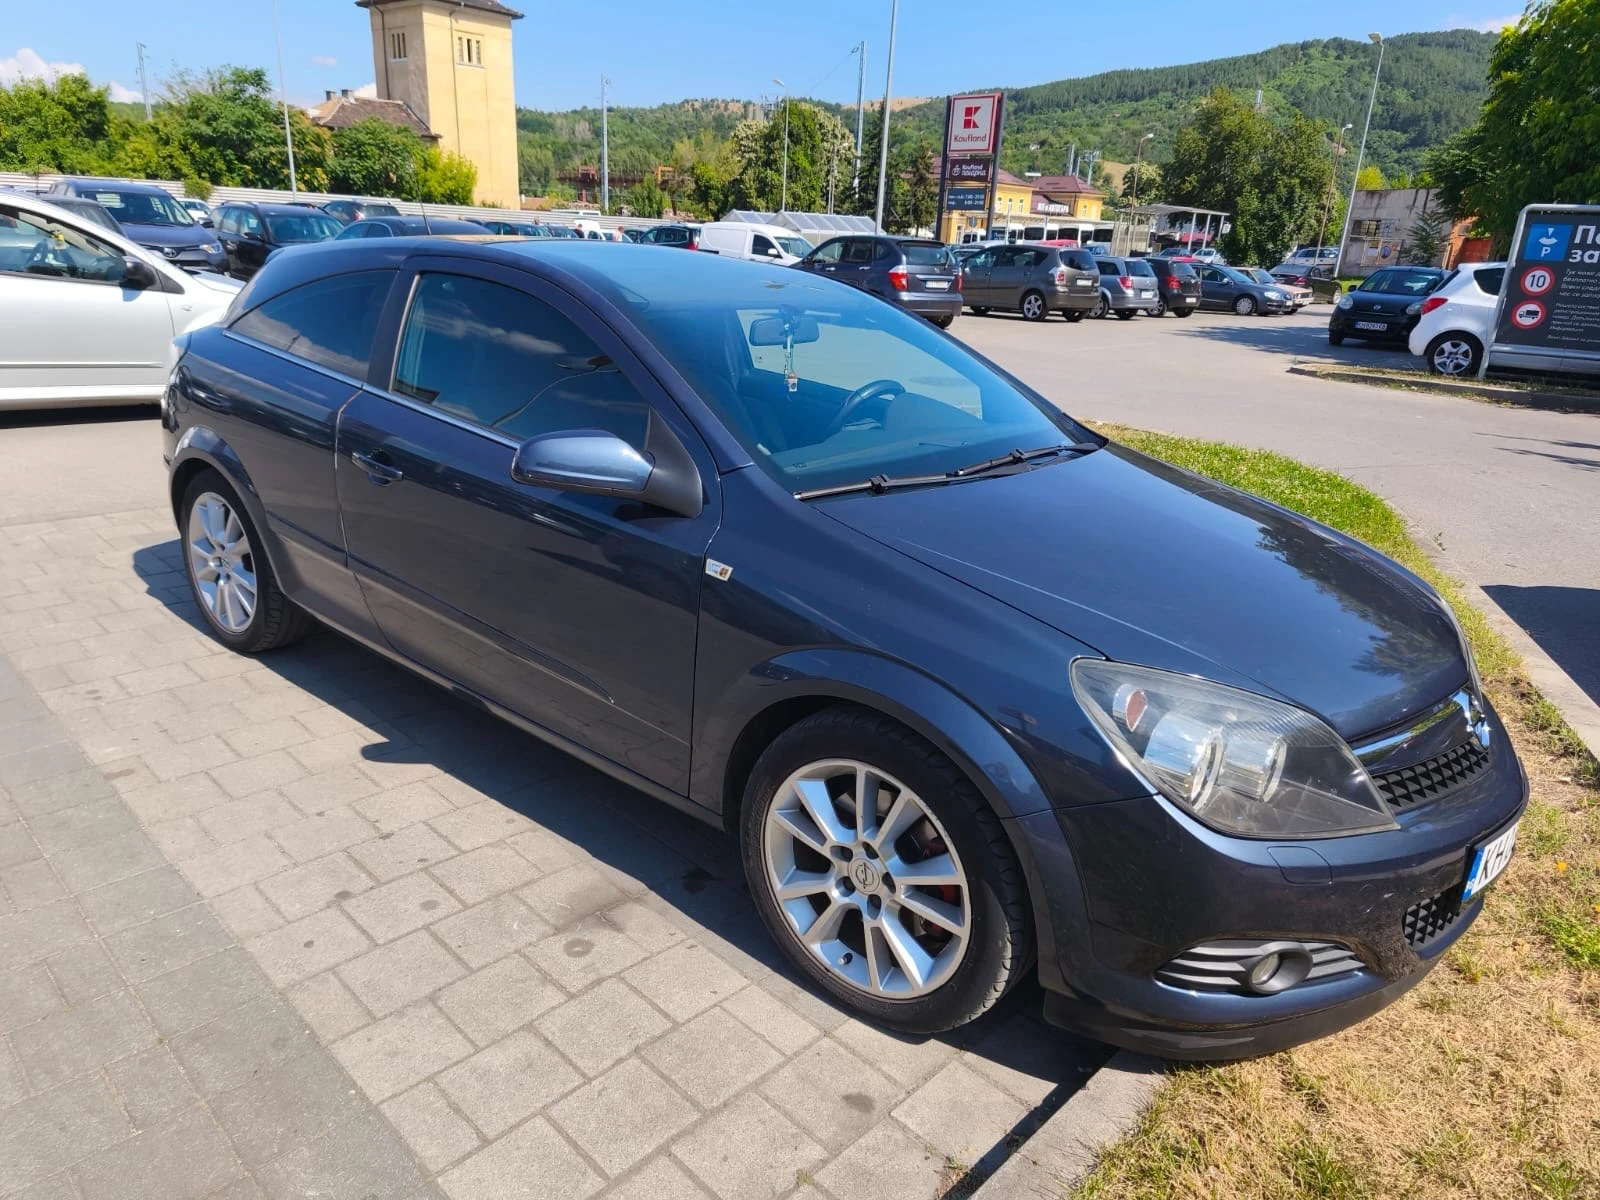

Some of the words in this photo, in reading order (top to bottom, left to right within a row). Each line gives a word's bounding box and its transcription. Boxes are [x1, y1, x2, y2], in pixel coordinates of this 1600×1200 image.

[953, 133, 987, 143] Kaufland
[1541, 246, 1551, 257] P
[1530, 275, 1546, 288] 10
